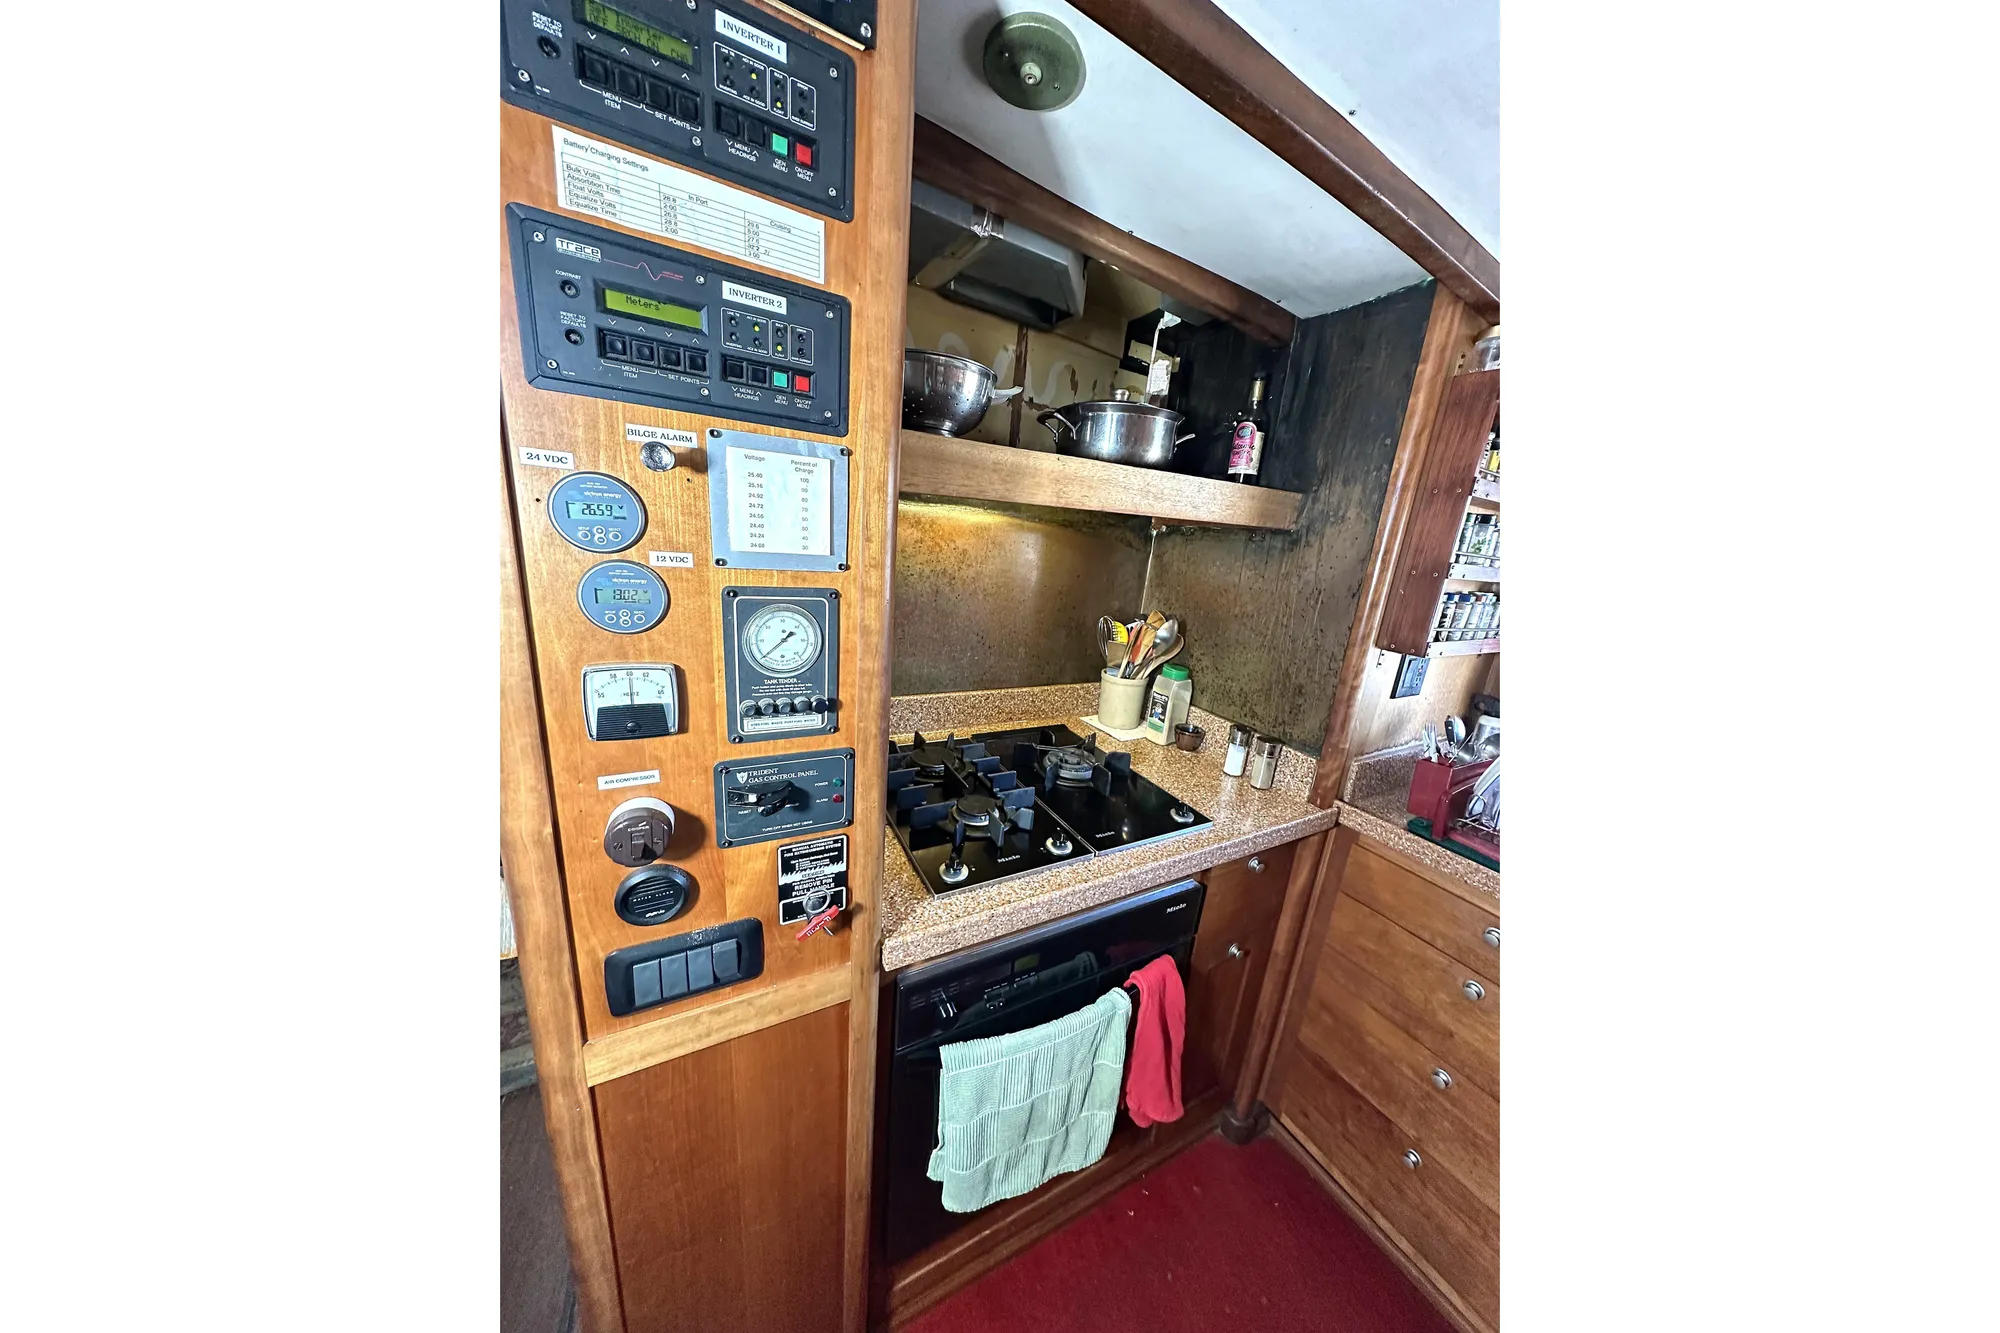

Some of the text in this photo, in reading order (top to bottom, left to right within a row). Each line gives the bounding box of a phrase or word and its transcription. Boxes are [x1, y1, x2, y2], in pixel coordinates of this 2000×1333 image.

[532, 11, 562, 28] RESET TO
[532, 16, 562, 32] FACTORY
[533, 22, 563, 38] DEFAULTS
[723, 19, 781, 54] INVERTER 1
[602, 91, 622, 103] MENU
[604, 99, 621, 110] ITEM
[655, 111, 691, 131] SET POINTS
[734, 143, 750, 153] MENU
[563, 138, 649, 172] Battery Charging Settings
[728, 148, 757, 162] HEADINGS
[772, 163, 788, 173] MENU
[774, 158, 786, 167] GEN
[566, 164, 582, 174] Bulk
[583, 168, 601, 180] Volts
[795, 166, 814, 177] ON/OFF
[797, 173, 812, 182] MENU
[568, 181, 586, 193] Float
[587, 187, 604, 198] Volts
[568, 190, 598, 204] Equalize
[600, 198, 617, 210] Volts
[696, 196, 708, 206] Port
[569, 198, 599, 212] Equalize
[601, 207, 618, 218] Time
[769, 220, 791, 233] Cruising
[558, 239, 599, 257] Trace
[555, 269, 581, 280] CONTRAST
[626, 295, 660, 311] Meters
[728, 287, 783, 309] INVERTER 2
[560, 320, 587, 329] DEFAULTS
[621, 365, 640, 373] MENU
[623, 371, 638, 379] ITEM
[680, 376, 700, 385] POINTS
[739, 387, 754, 395] MENU
[734, 392, 760, 402] HEADINGS
[774, 398, 788, 406] MENU
[627, 428, 693, 443] BILGE ALARM
[526, 452, 569, 465] 24 VDC
[744, 453, 765, 462] Voltage
[749, 768, 779, 776] TRIDENT
[764, 773, 798, 781] CONTROL
[797, 769, 818, 777] PANEL
[615, 774, 656, 784] COMPRESSOR
[1095, 831, 1115, 839] Miele
[997, 853, 1021, 864] Miele
[795, 880, 821, 890] REMOVE
[792, 889, 808, 897] PULL
[1166, 902, 1187, 914] Miele
